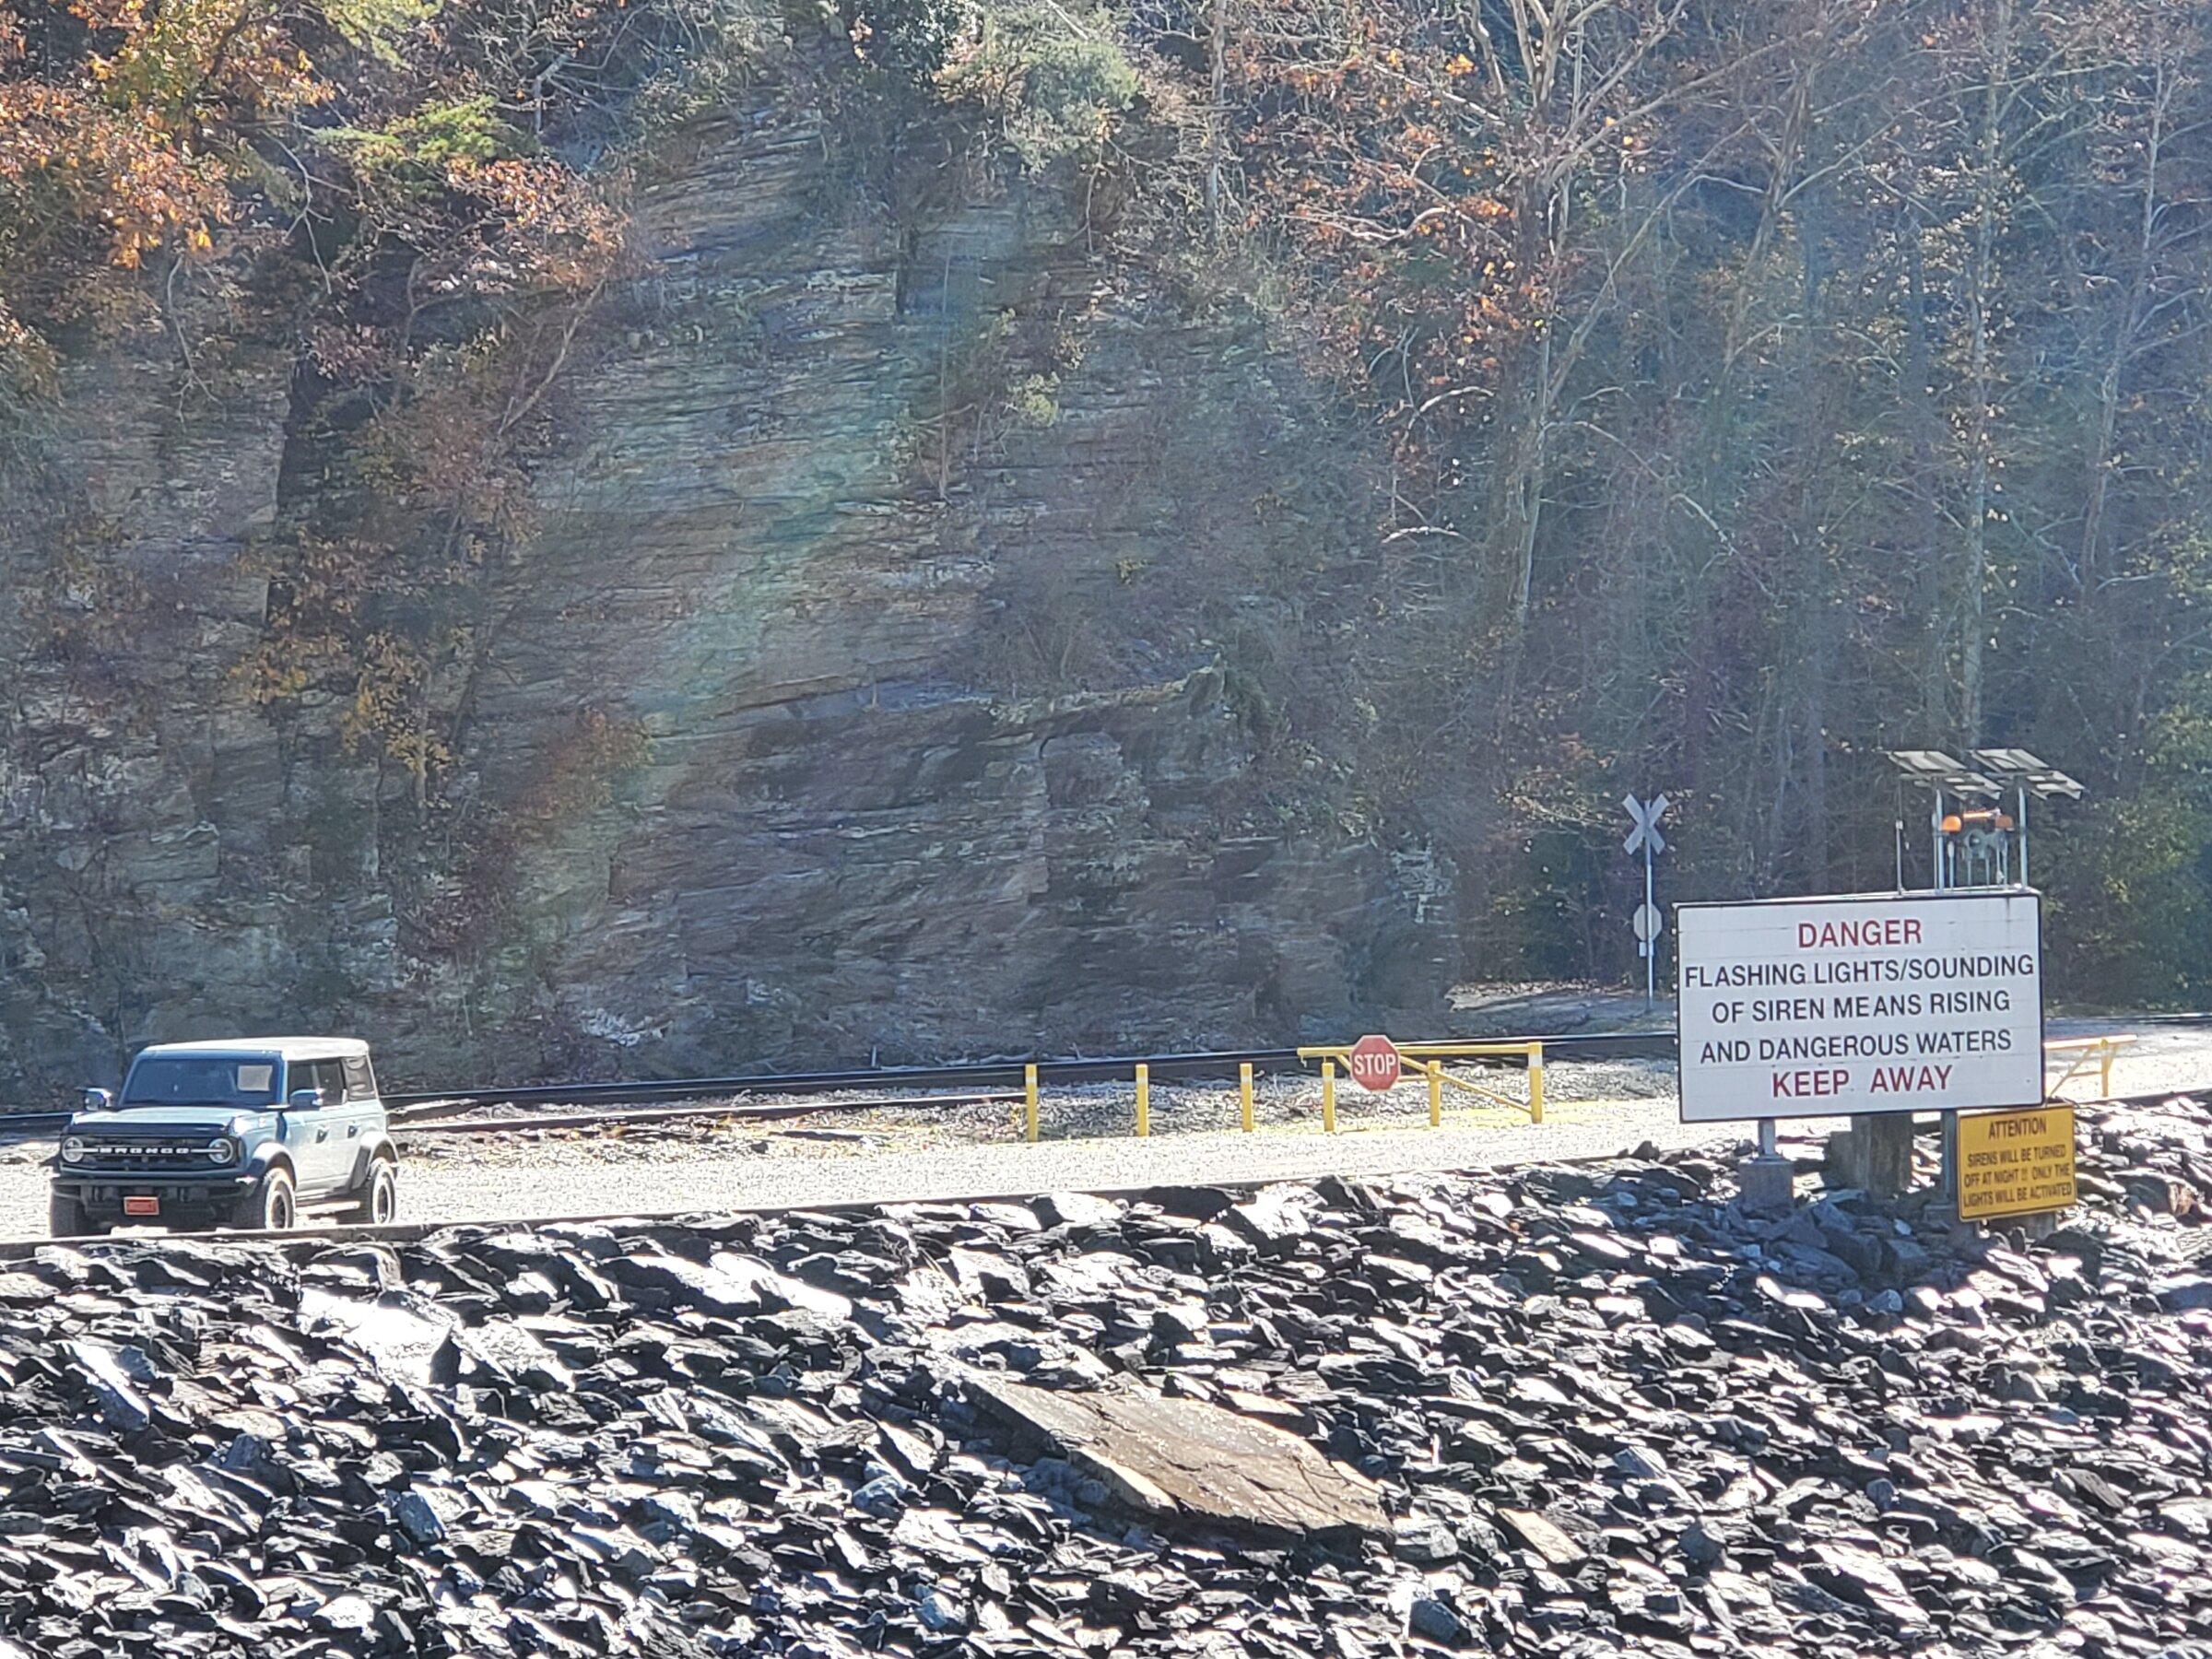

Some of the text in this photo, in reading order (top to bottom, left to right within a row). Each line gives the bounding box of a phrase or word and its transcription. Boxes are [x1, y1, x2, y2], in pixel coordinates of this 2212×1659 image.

[1798, 919, 1922, 948] DANGER
[1685, 954, 2034, 988] FLASHING LIGHTS/SOUNDING
[1712, 990, 2010, 1024] OF SIREN MEANS RISING
[1700, 1029, 2011, 1064] AND DANGEROUS WATERS
[1354, 1053, 1396, 1076] STOP
[1772, 1065, 1953, 1098] KEEP AWAY
[1988, 1117, 2047, 1139] ATTENTION
[1967, 1144, 2065, 1167] SIRENS WILL BE TURNED
[1964, 1173, 1980, 1187] OFF
[1982, 1171, 1993, 1185] AT
[1994, 1169, 2018, 1184] NIGHT
[2031, 1164, 2053, 1180] ONLY
[2054, 1162, 2070, 1176] THE
[1963, 1182, 2072, 1207] LIGHTS WILL BE ACTIVATED
